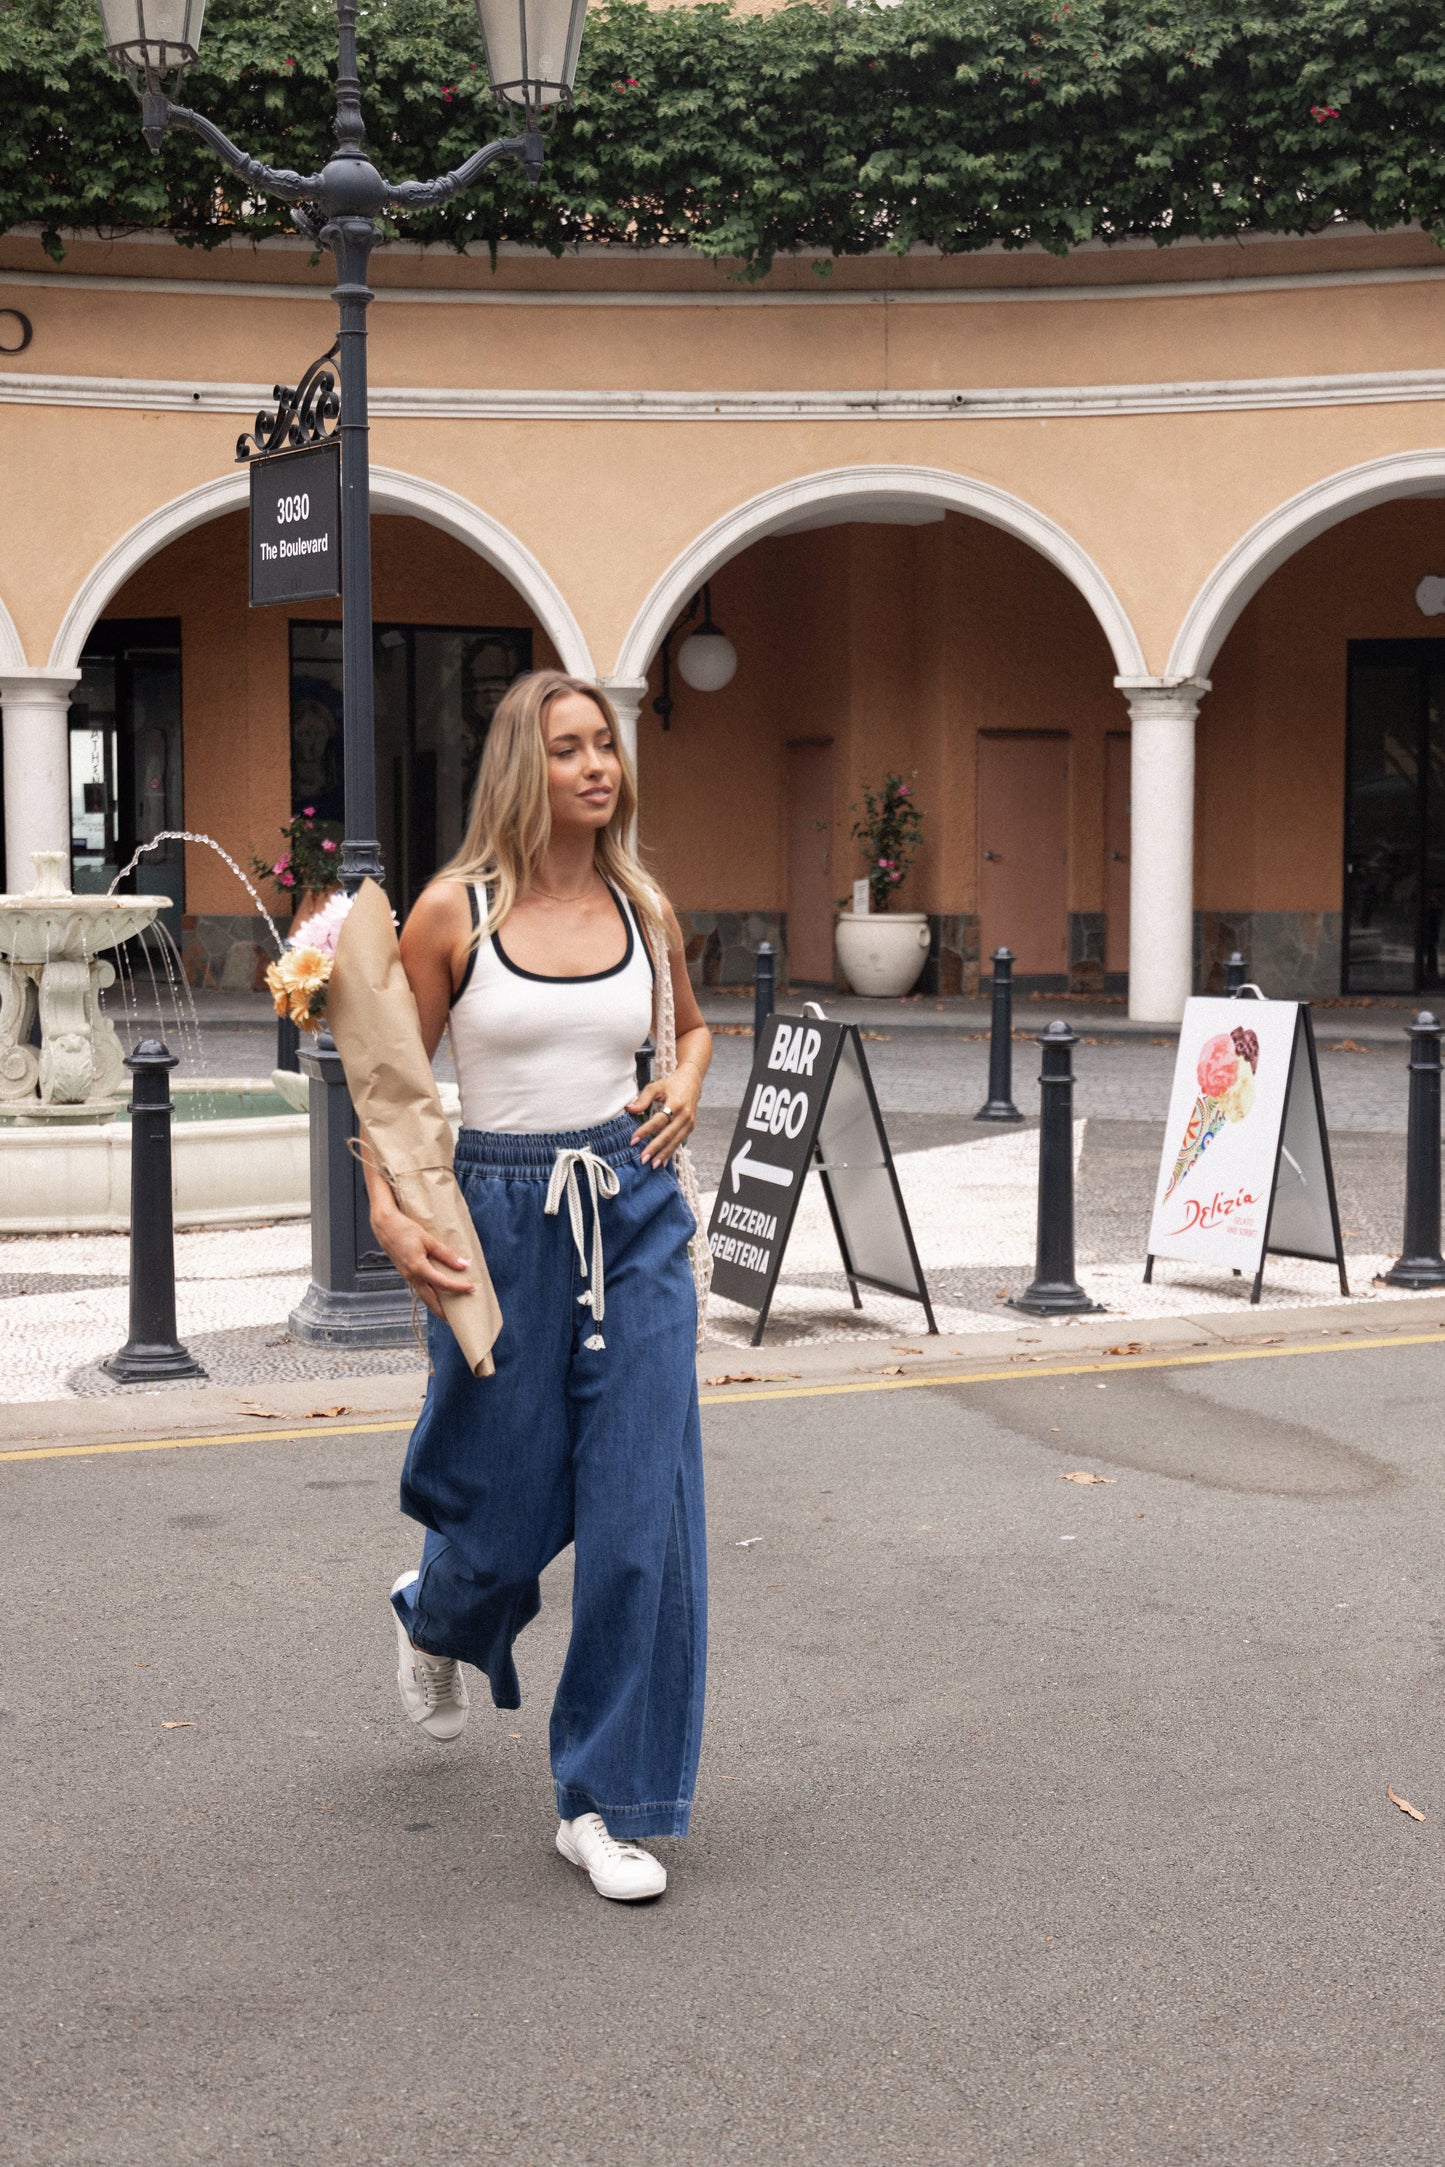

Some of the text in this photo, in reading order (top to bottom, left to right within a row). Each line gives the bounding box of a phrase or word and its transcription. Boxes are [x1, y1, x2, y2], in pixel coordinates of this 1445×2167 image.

[277, 493, 310, 525] 3030
[260, 533, 329, 561] The Boulevard
[767, 1023, 822, 1077] BAR
[746, 1083, 809, 1140] LAGO
[717, 1201, 778, 1241] PIZZERIA
[709, 1231, 771, 1275] GELATERIA
